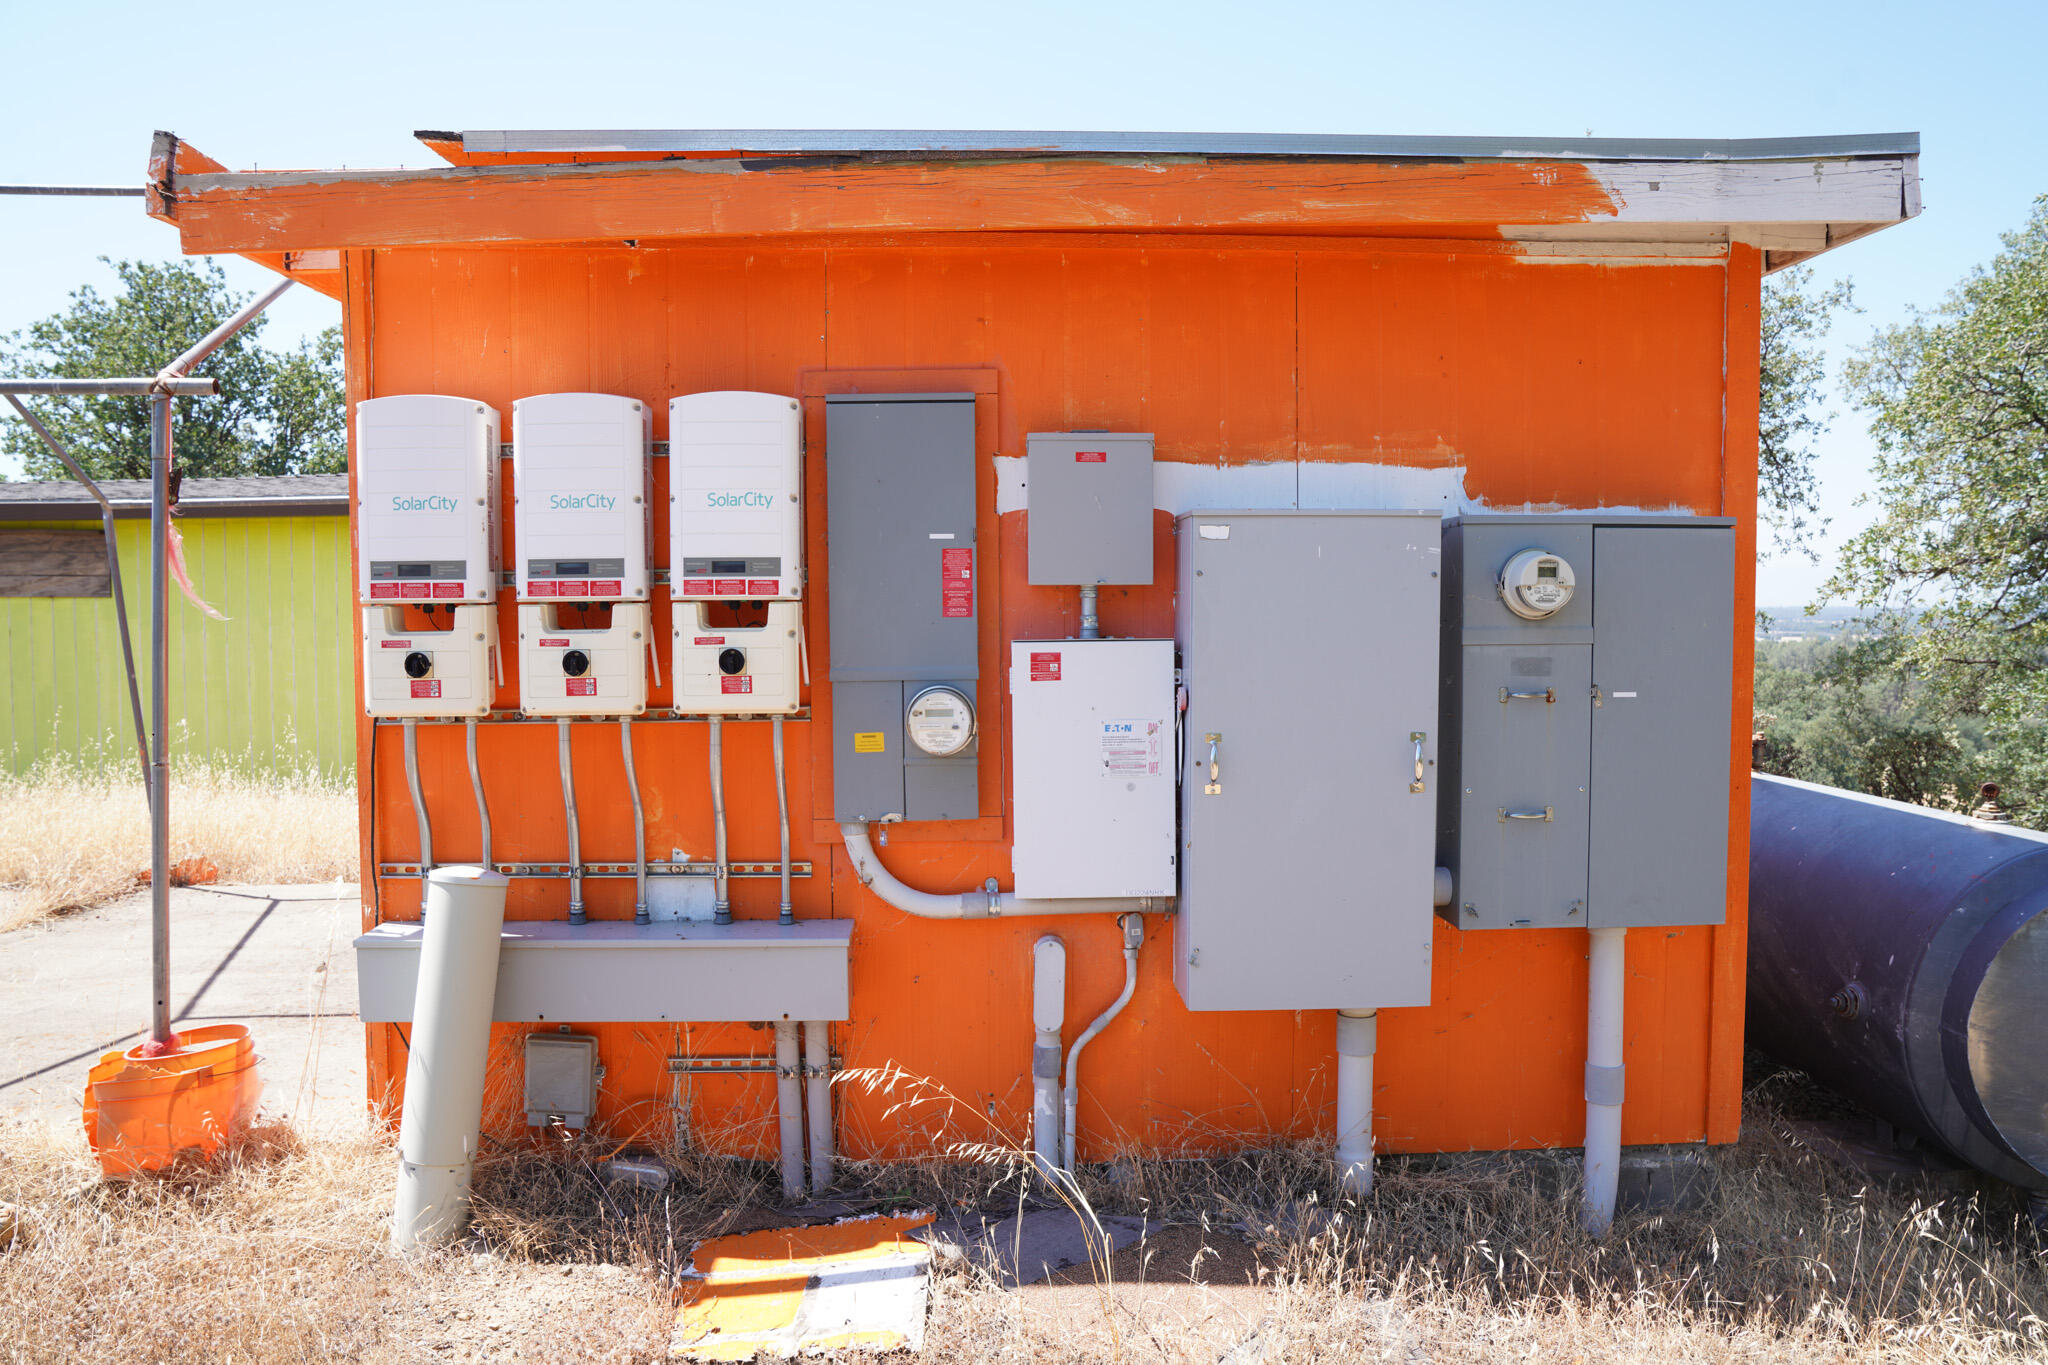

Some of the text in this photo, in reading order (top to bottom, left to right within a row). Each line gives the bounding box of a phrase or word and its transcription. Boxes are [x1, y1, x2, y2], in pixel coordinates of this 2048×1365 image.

[392, 495, 458, 512] SolarCity
[550, 493, 616, 511] SolarCity
[707, 491, 773, 509] SolarCity
[1148, 761, 1159, 775] OFF
